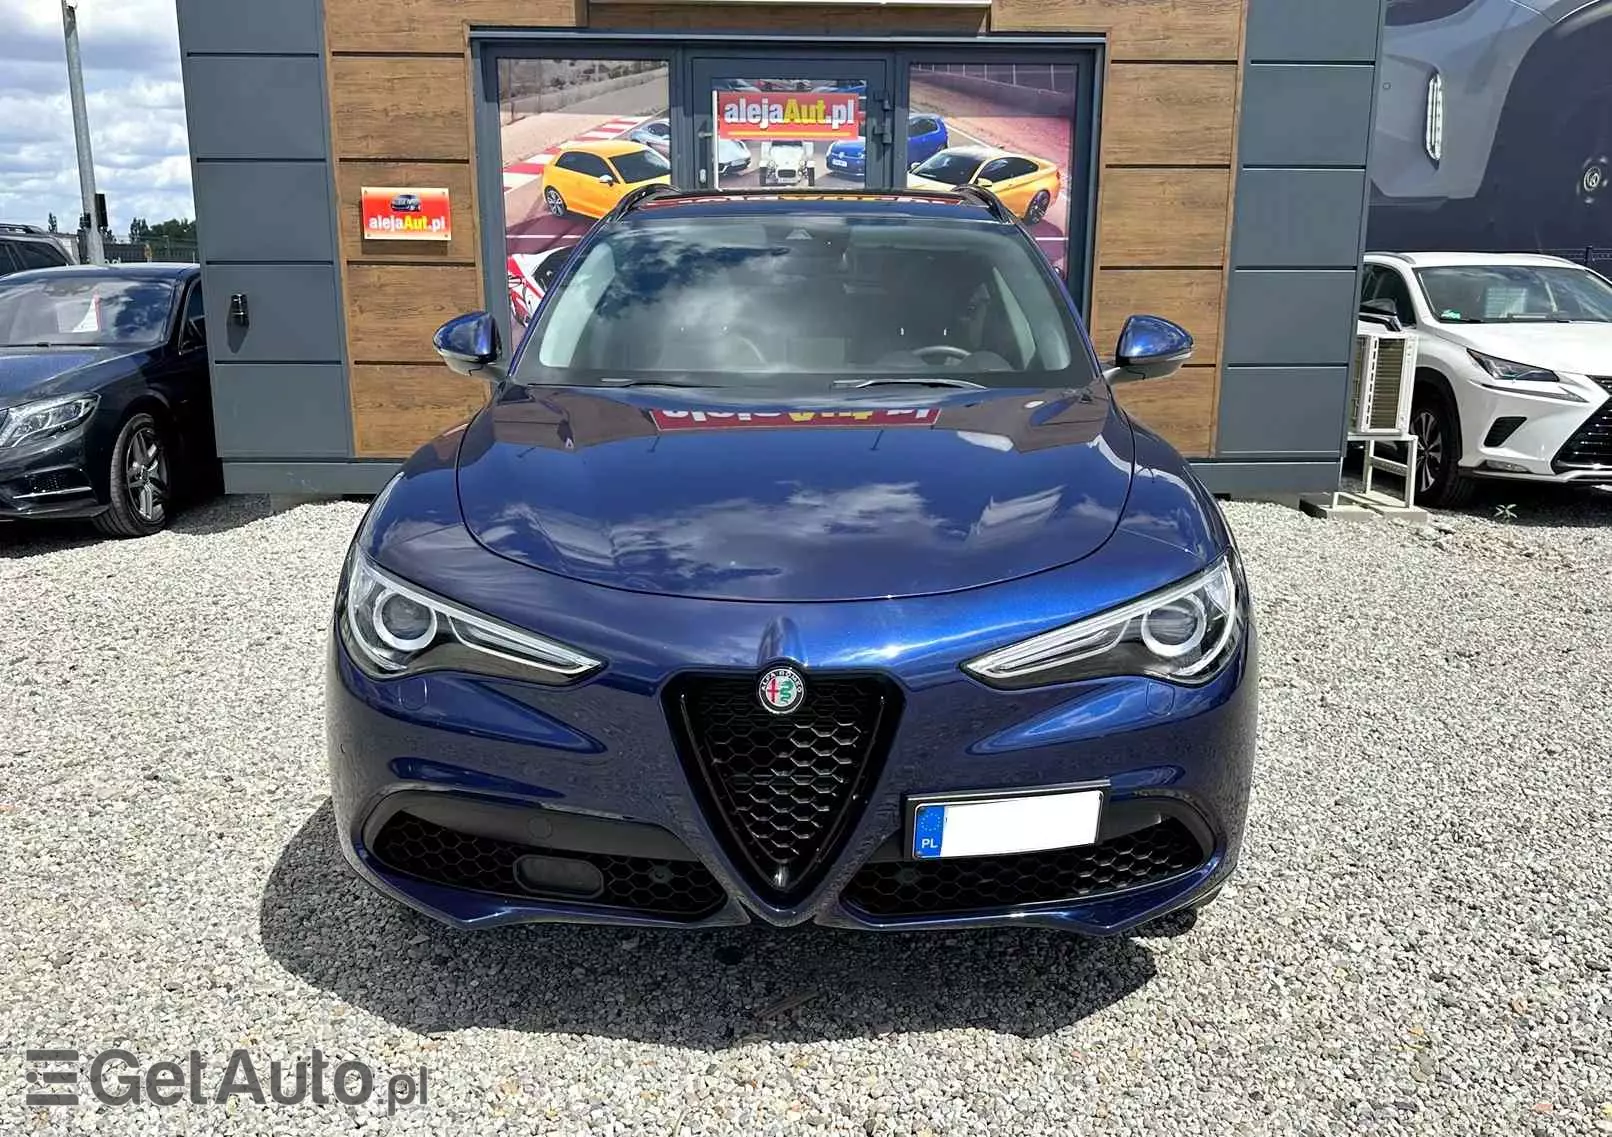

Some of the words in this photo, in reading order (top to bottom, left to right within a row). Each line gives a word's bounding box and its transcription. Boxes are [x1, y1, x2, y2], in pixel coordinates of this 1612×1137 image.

[723, 97, 854, 130] alejaAut.pl
[368, 215, 446, 232] alejaAut.pl
[921, 838, 938, 849] PL
